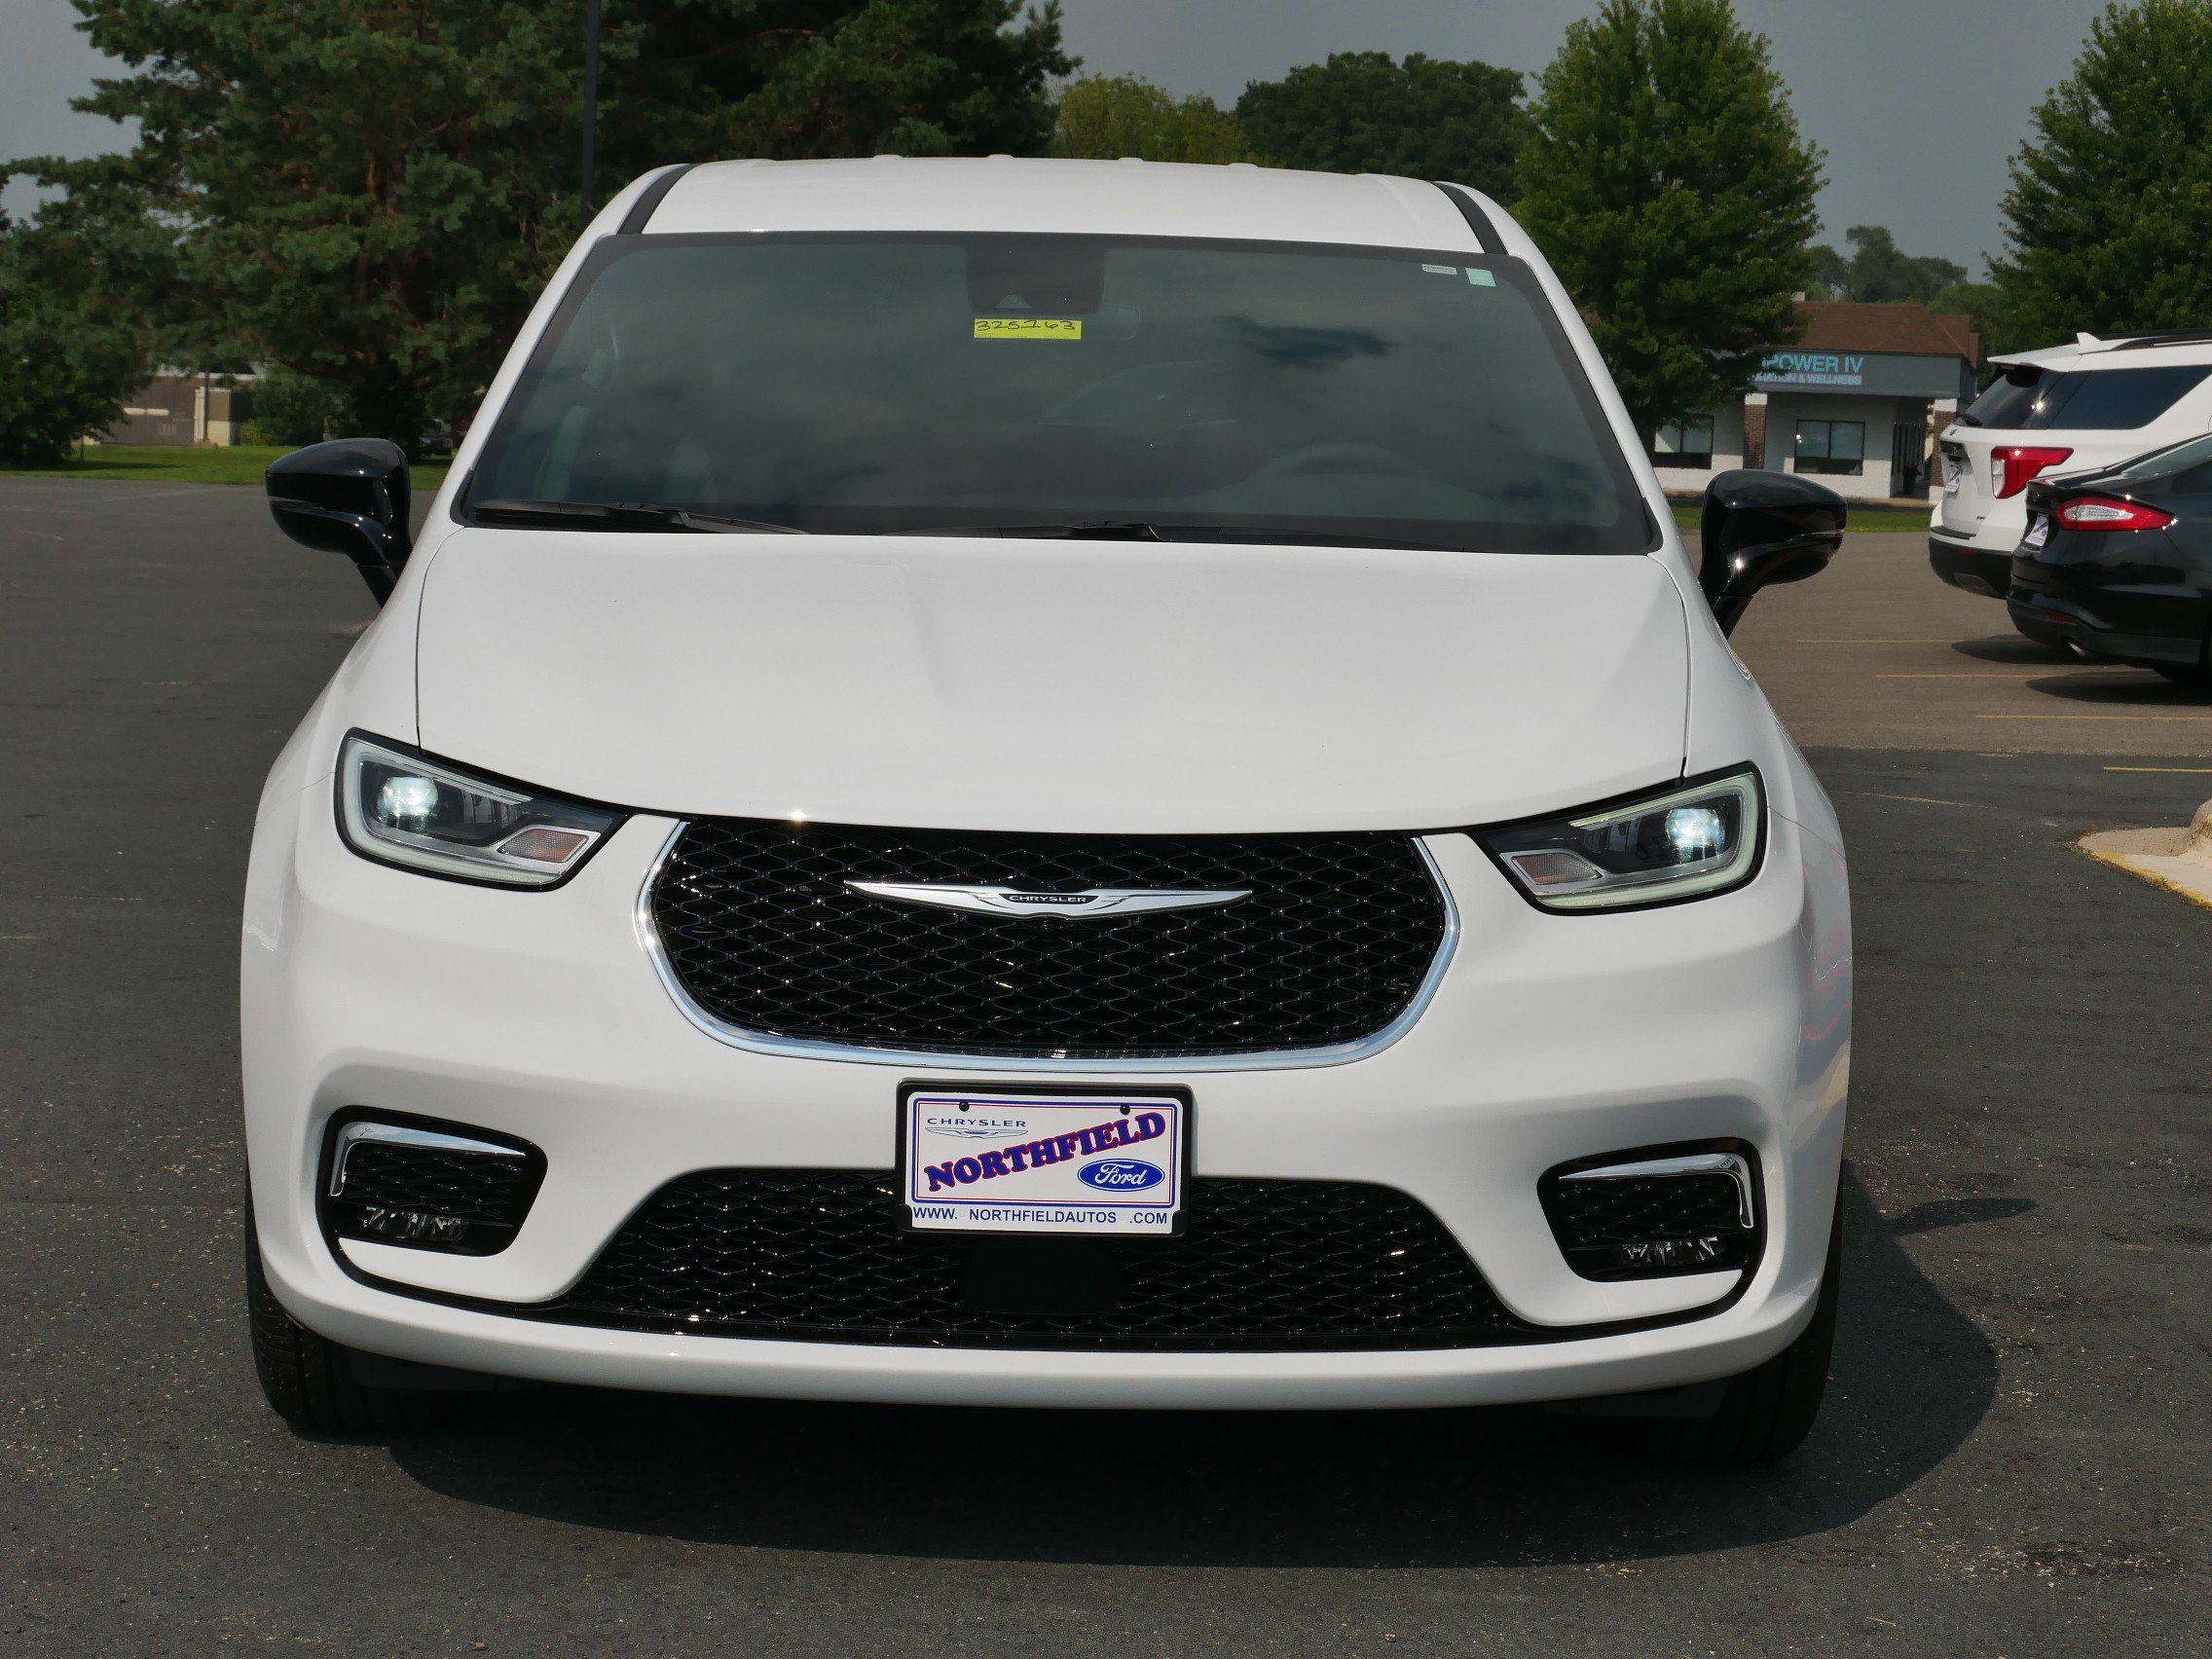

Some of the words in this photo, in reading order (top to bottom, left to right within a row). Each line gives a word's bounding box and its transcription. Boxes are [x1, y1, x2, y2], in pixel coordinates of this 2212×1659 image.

[1761, 353, 1839, 373] POWER
[1845, 356, 1864, 373] IV
[1807, 374, 1862, 386] WELLNESS
[927, 1118, 1027, 1127] CHRYSLER
[924, 1112, 1166, 1193] NORTHFIELD
[1094, 1162, 1148, 1185] Ford
[969, 1208, 1117, 1224] NORTHFIELDAUTOS
[1129, 1212, 1168, 1225] .COM
